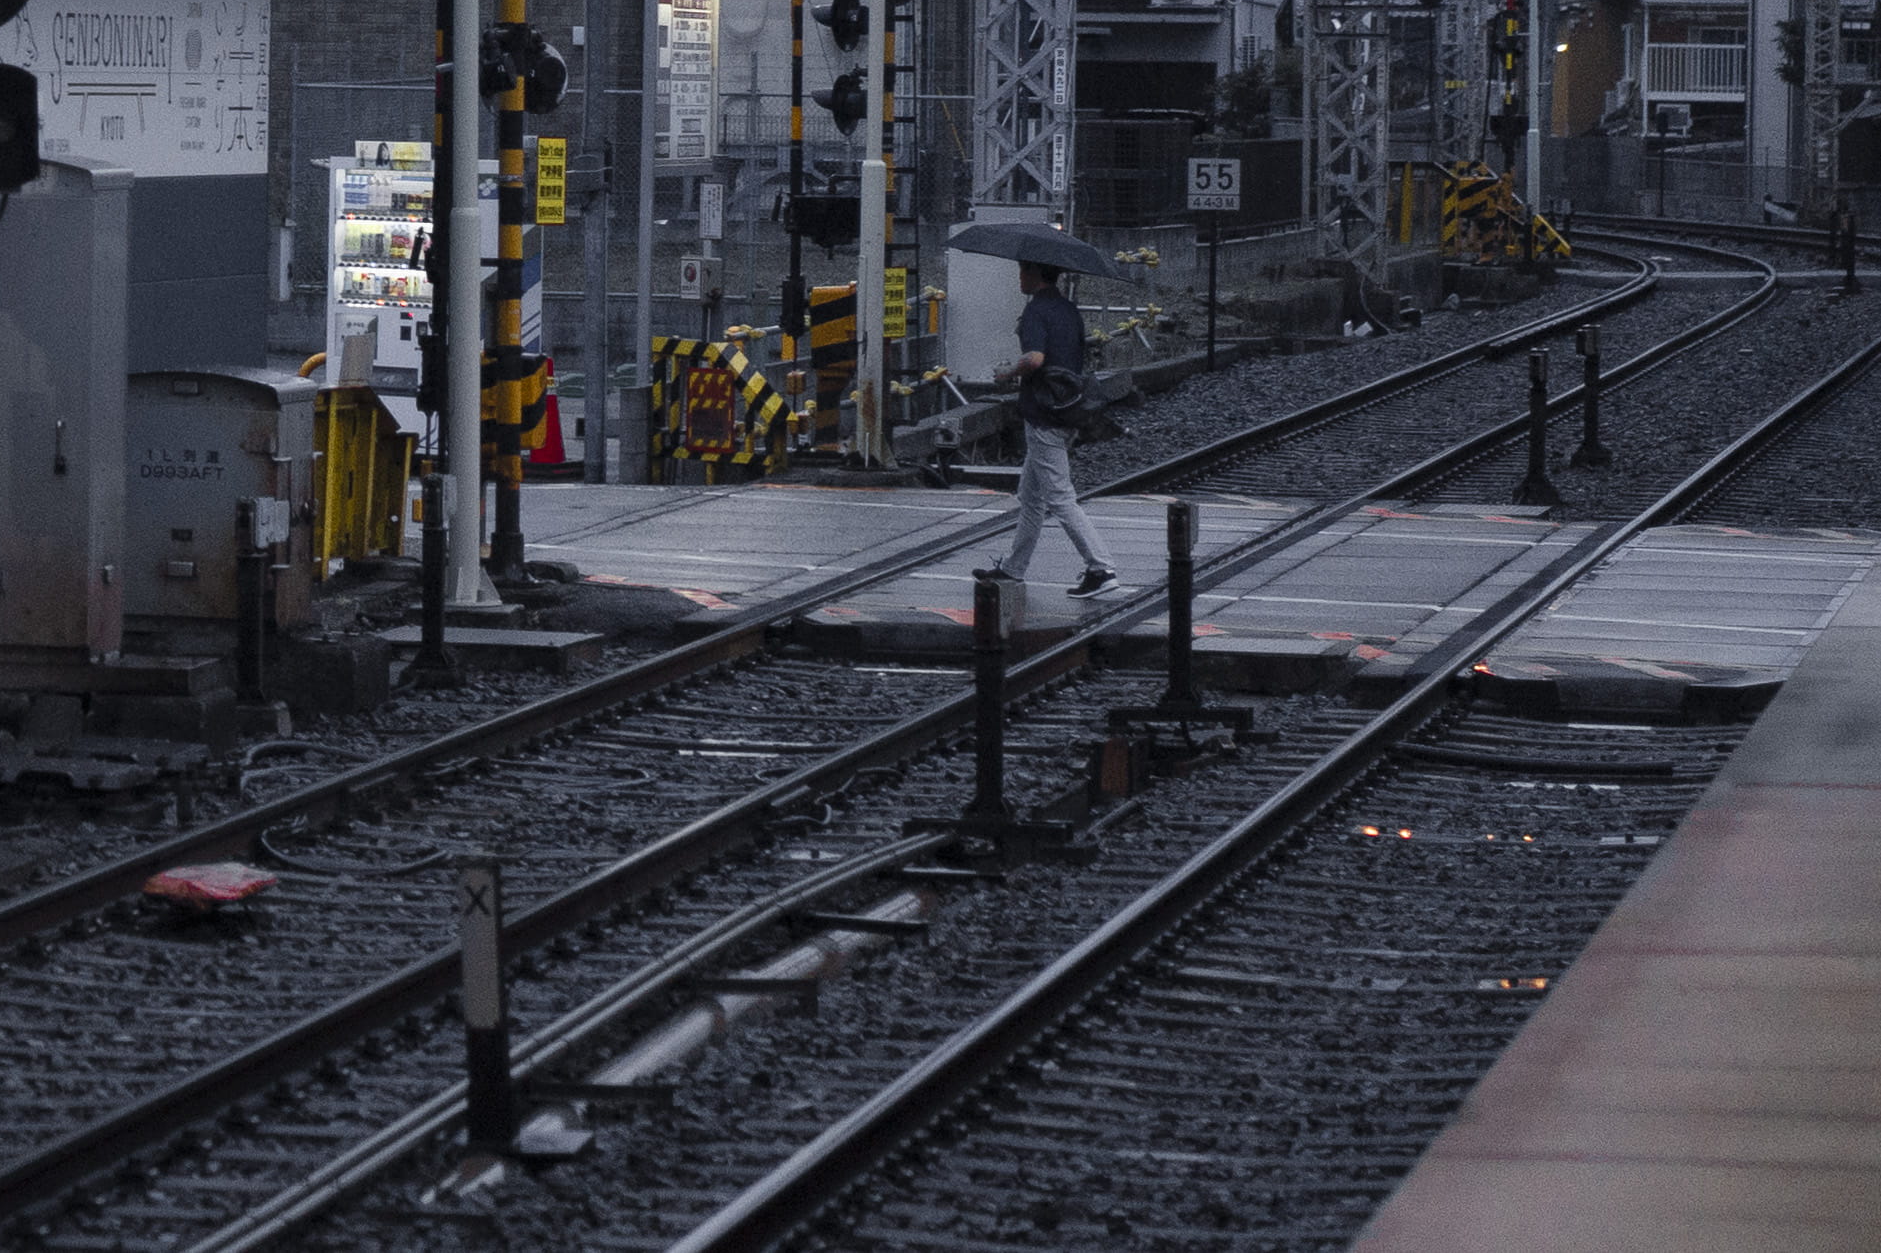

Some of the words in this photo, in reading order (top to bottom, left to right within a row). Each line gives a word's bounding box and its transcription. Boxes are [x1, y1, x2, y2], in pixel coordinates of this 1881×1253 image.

[49, 11, 173, 106] SENBONINARI
[100, 115, 125, 141] KYOTO
[1195, 163, 1233, 190] 55
